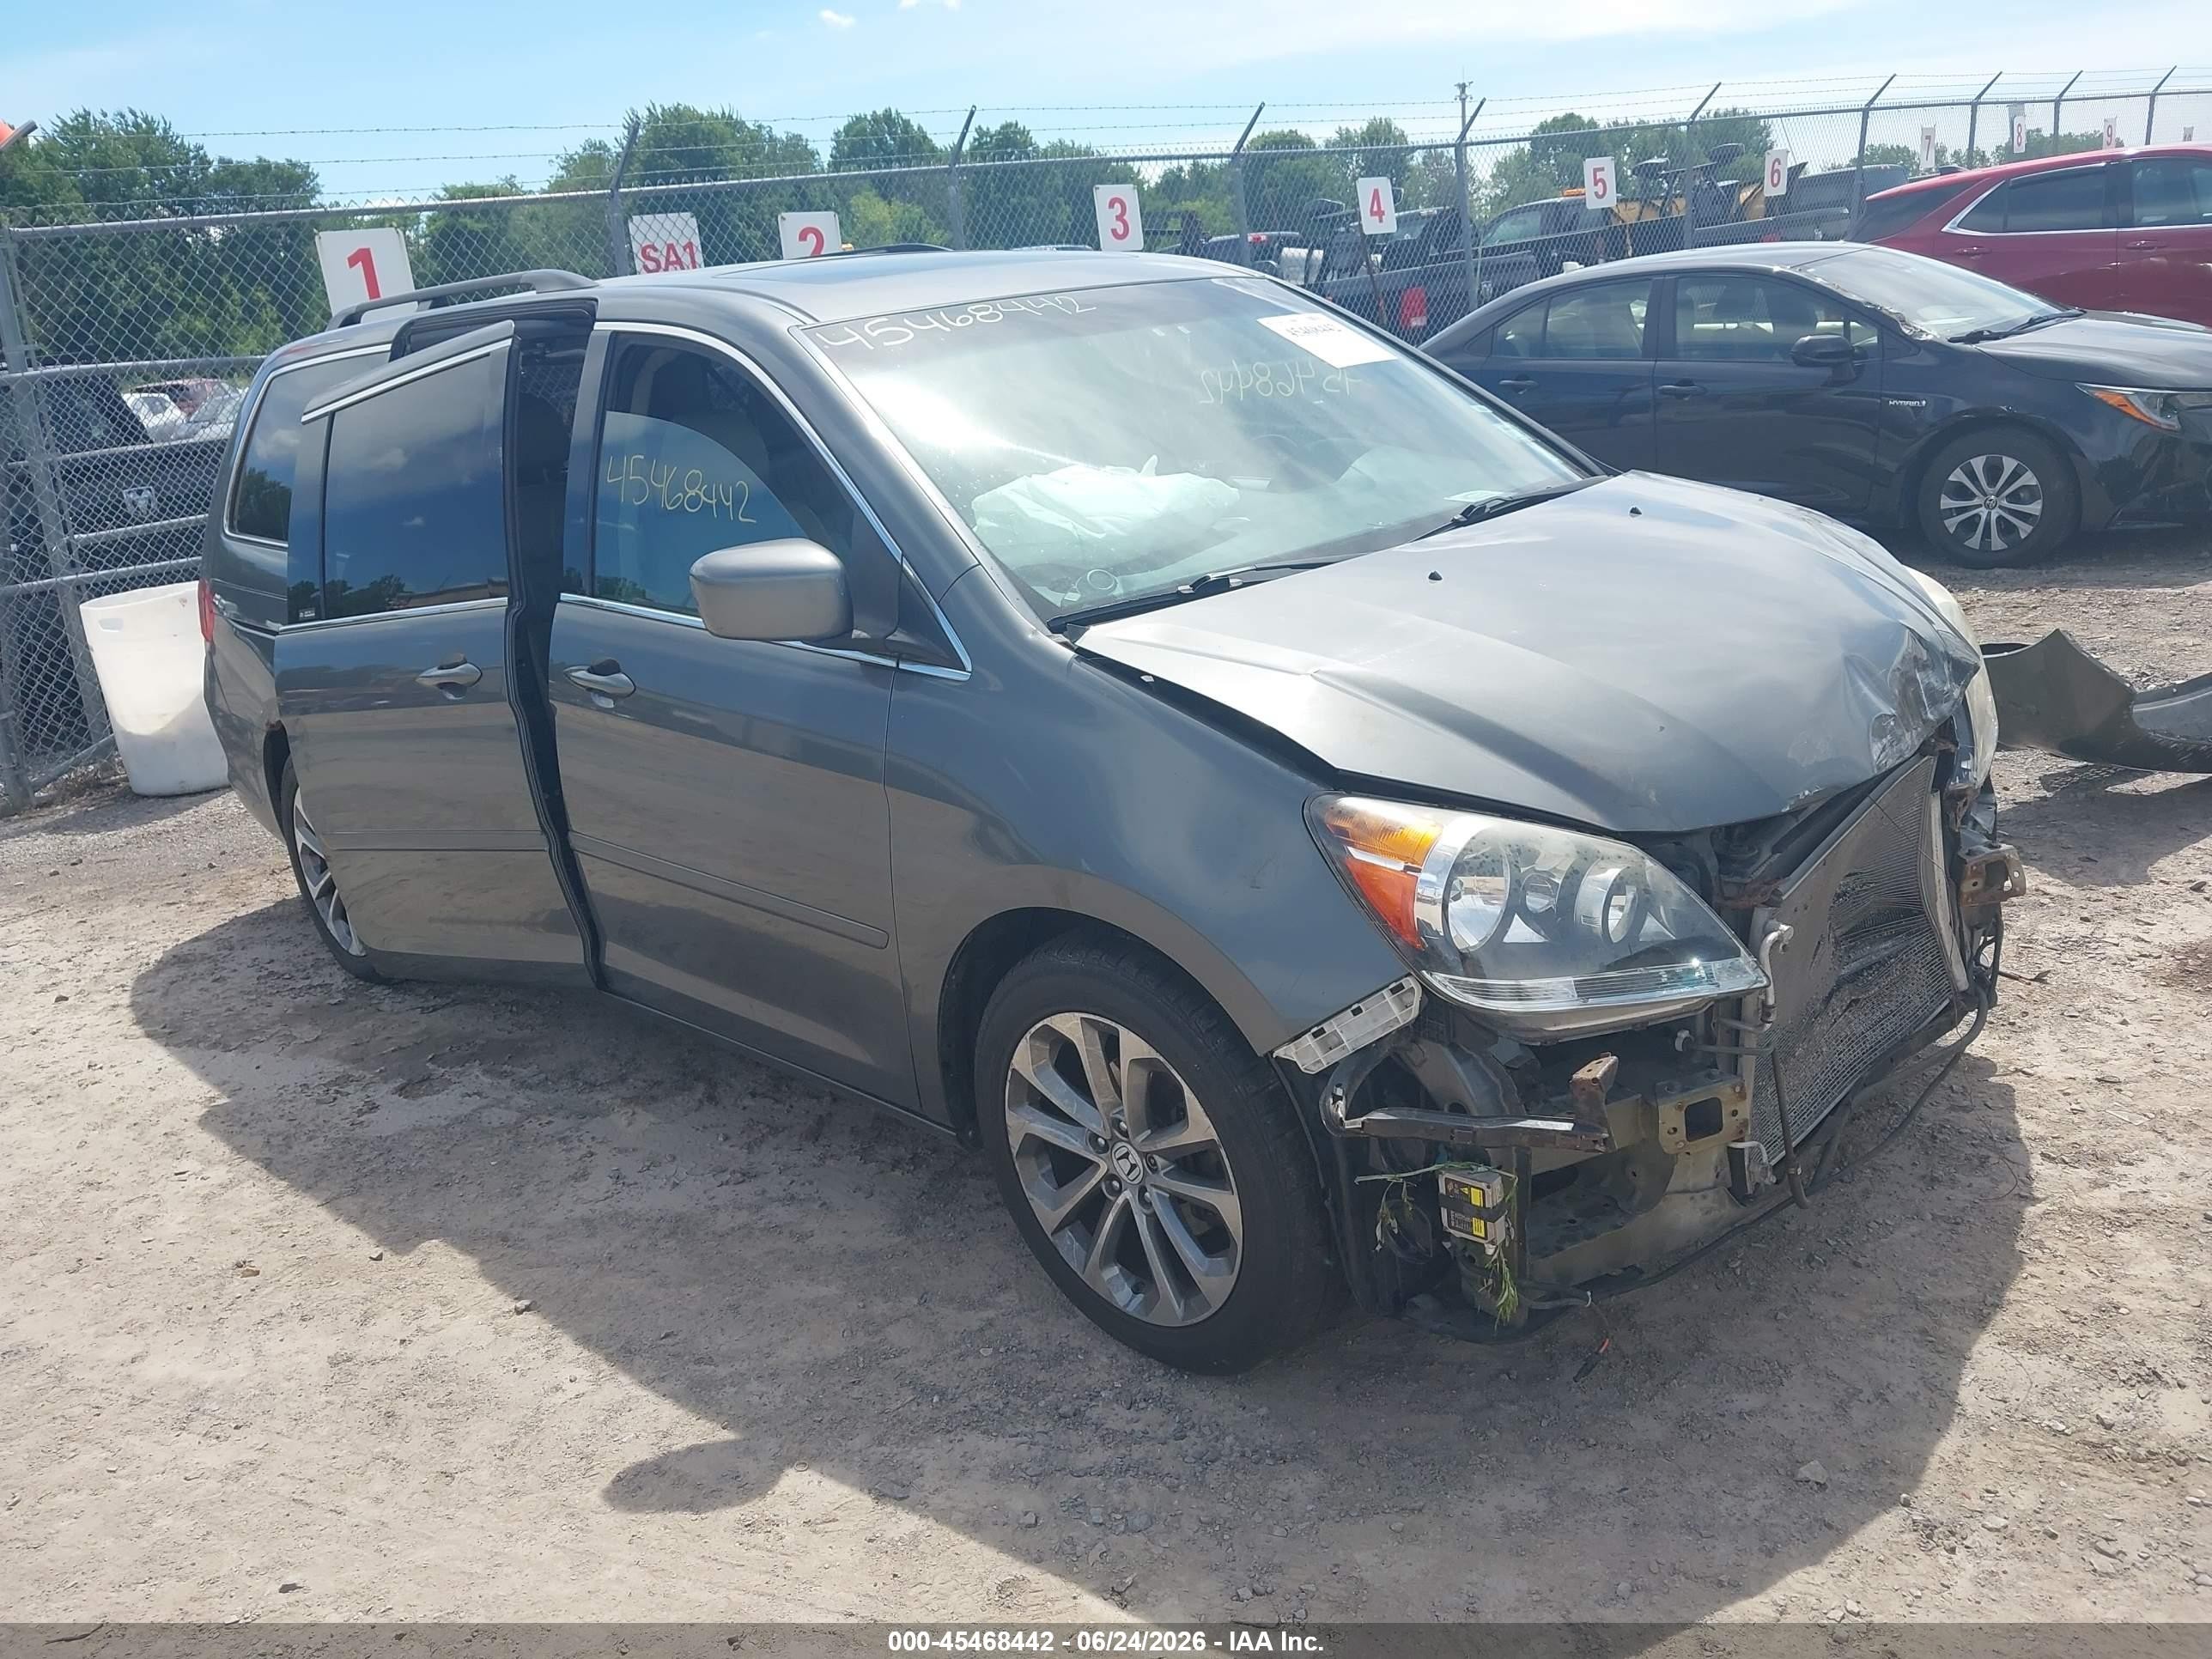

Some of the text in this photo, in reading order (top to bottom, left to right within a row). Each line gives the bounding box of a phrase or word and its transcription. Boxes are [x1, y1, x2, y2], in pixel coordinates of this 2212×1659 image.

[1924, 135, 1931, 161] 7
[2016, 123, 2022, 147] 8
[2106, 124, 2113, 146] 9
[1592, 167, 1607, 199] 5
[1771, 157, 1781, 188] 6
[1108, 197, 1130, 240] 3
[1370, 188, 1385, 223] 4
[641, 240, 697, 274] SA1
[798, 226, 824, 257] 2
[347, 246, 381, 301] 1
[816, 295, 1097, 350] 45468442
[606, 454, 757, 523] 45468442
